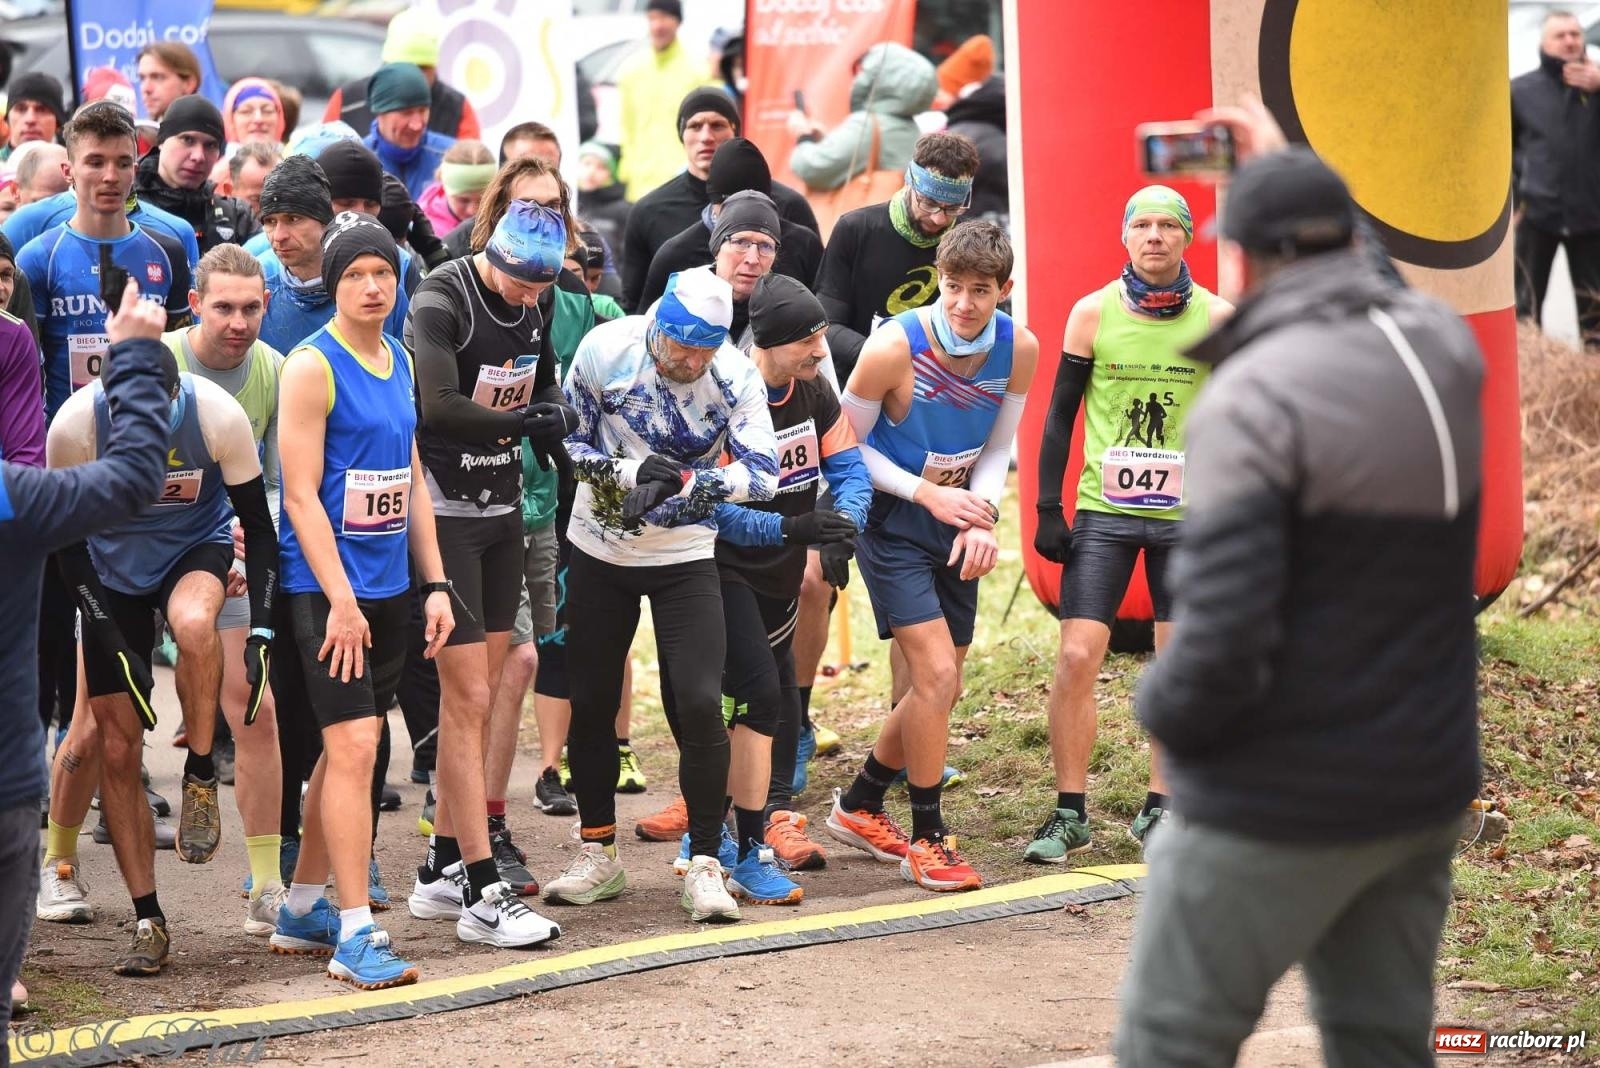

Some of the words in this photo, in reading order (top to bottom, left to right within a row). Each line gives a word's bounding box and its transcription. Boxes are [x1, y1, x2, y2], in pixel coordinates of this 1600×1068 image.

[487, 368, 507, 378] BIEG
[491, 384, 526, 407] 184
[1162, 391, 1174, 407] 5
[460, 451, 511, 472] RUNNERS
[780, 443, 808, 471] 48
[354, 473, 375, 482] BIEG
[1117, 467, 1169, 492] 047
[365, 491, 403, 517] 165
